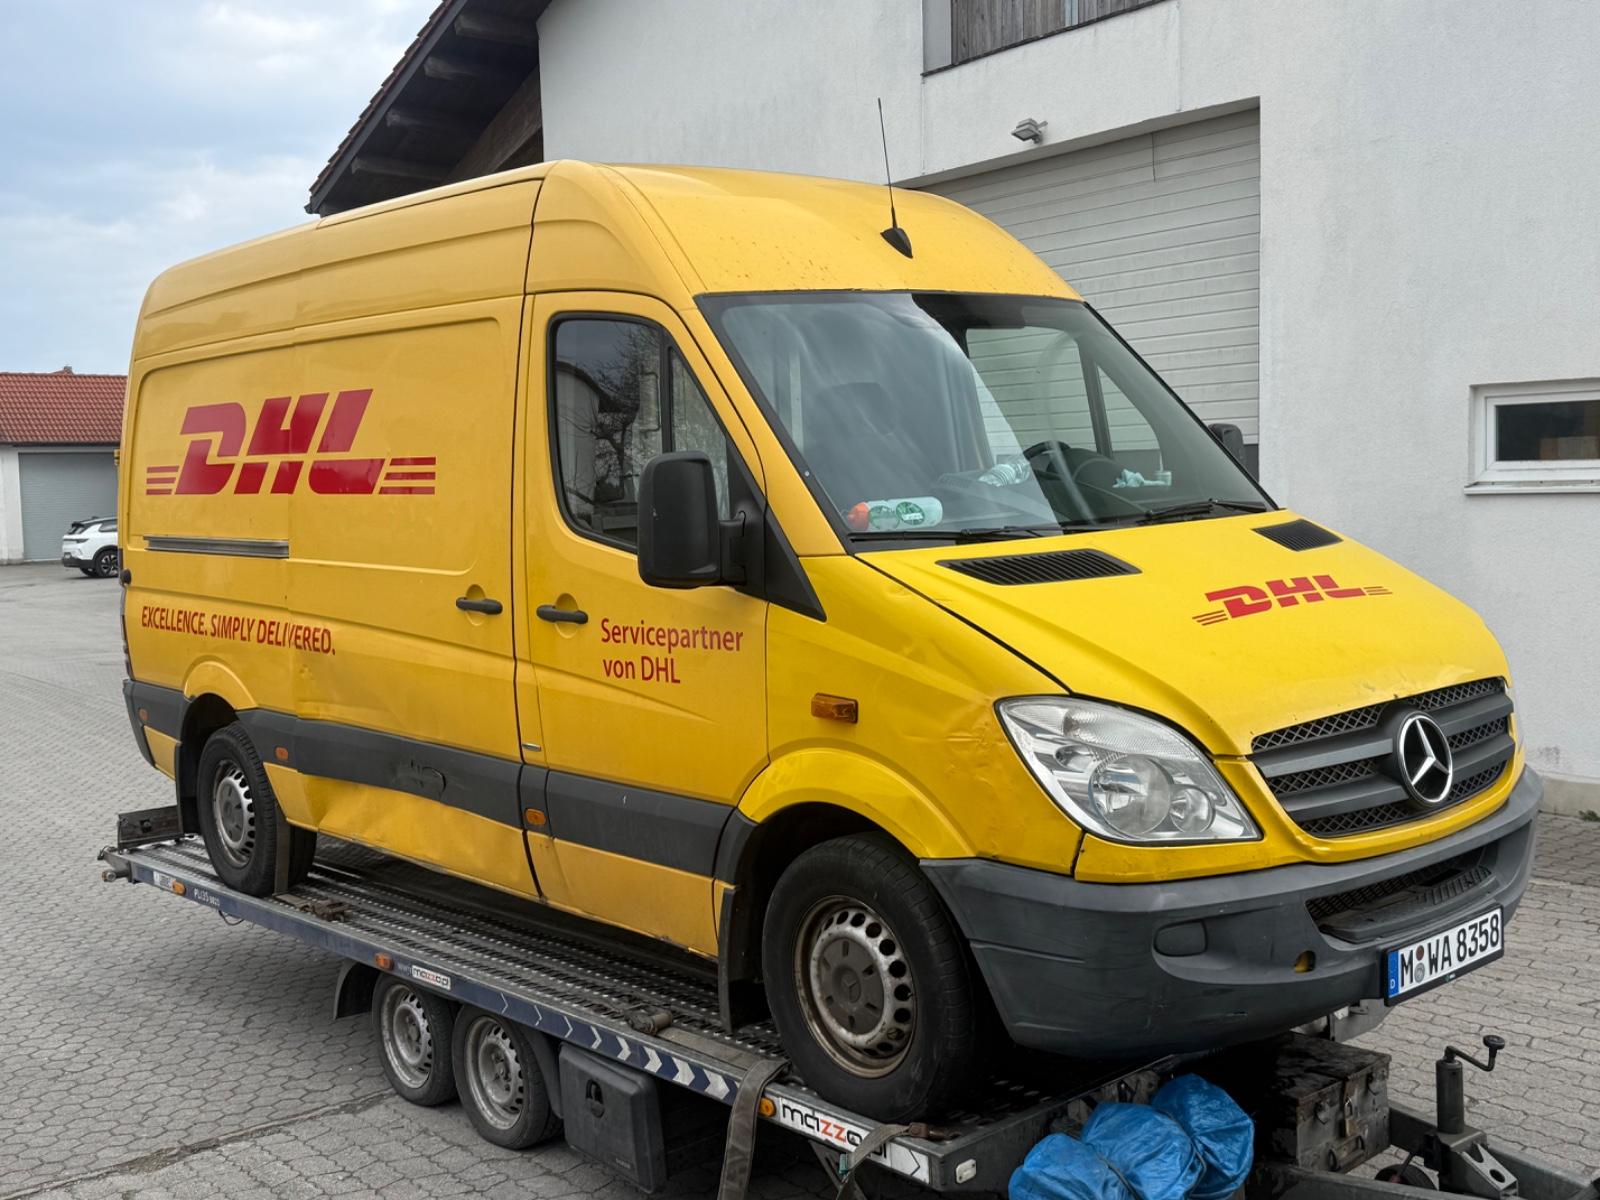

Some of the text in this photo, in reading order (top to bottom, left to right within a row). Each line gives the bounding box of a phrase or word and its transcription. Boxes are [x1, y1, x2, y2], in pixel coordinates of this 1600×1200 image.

[174, 388, 386, 495] DHL
[1204, 574, 1366, 619] DHL
[141, 605, 336, 656] EXCELLENCE. SIMPLY DELIVERED.
[601, 617, 744, 655] Servicepartner
[603, 655, 681, 684] von DHL
[1400, 913, 1500, 988] M WA 8358
